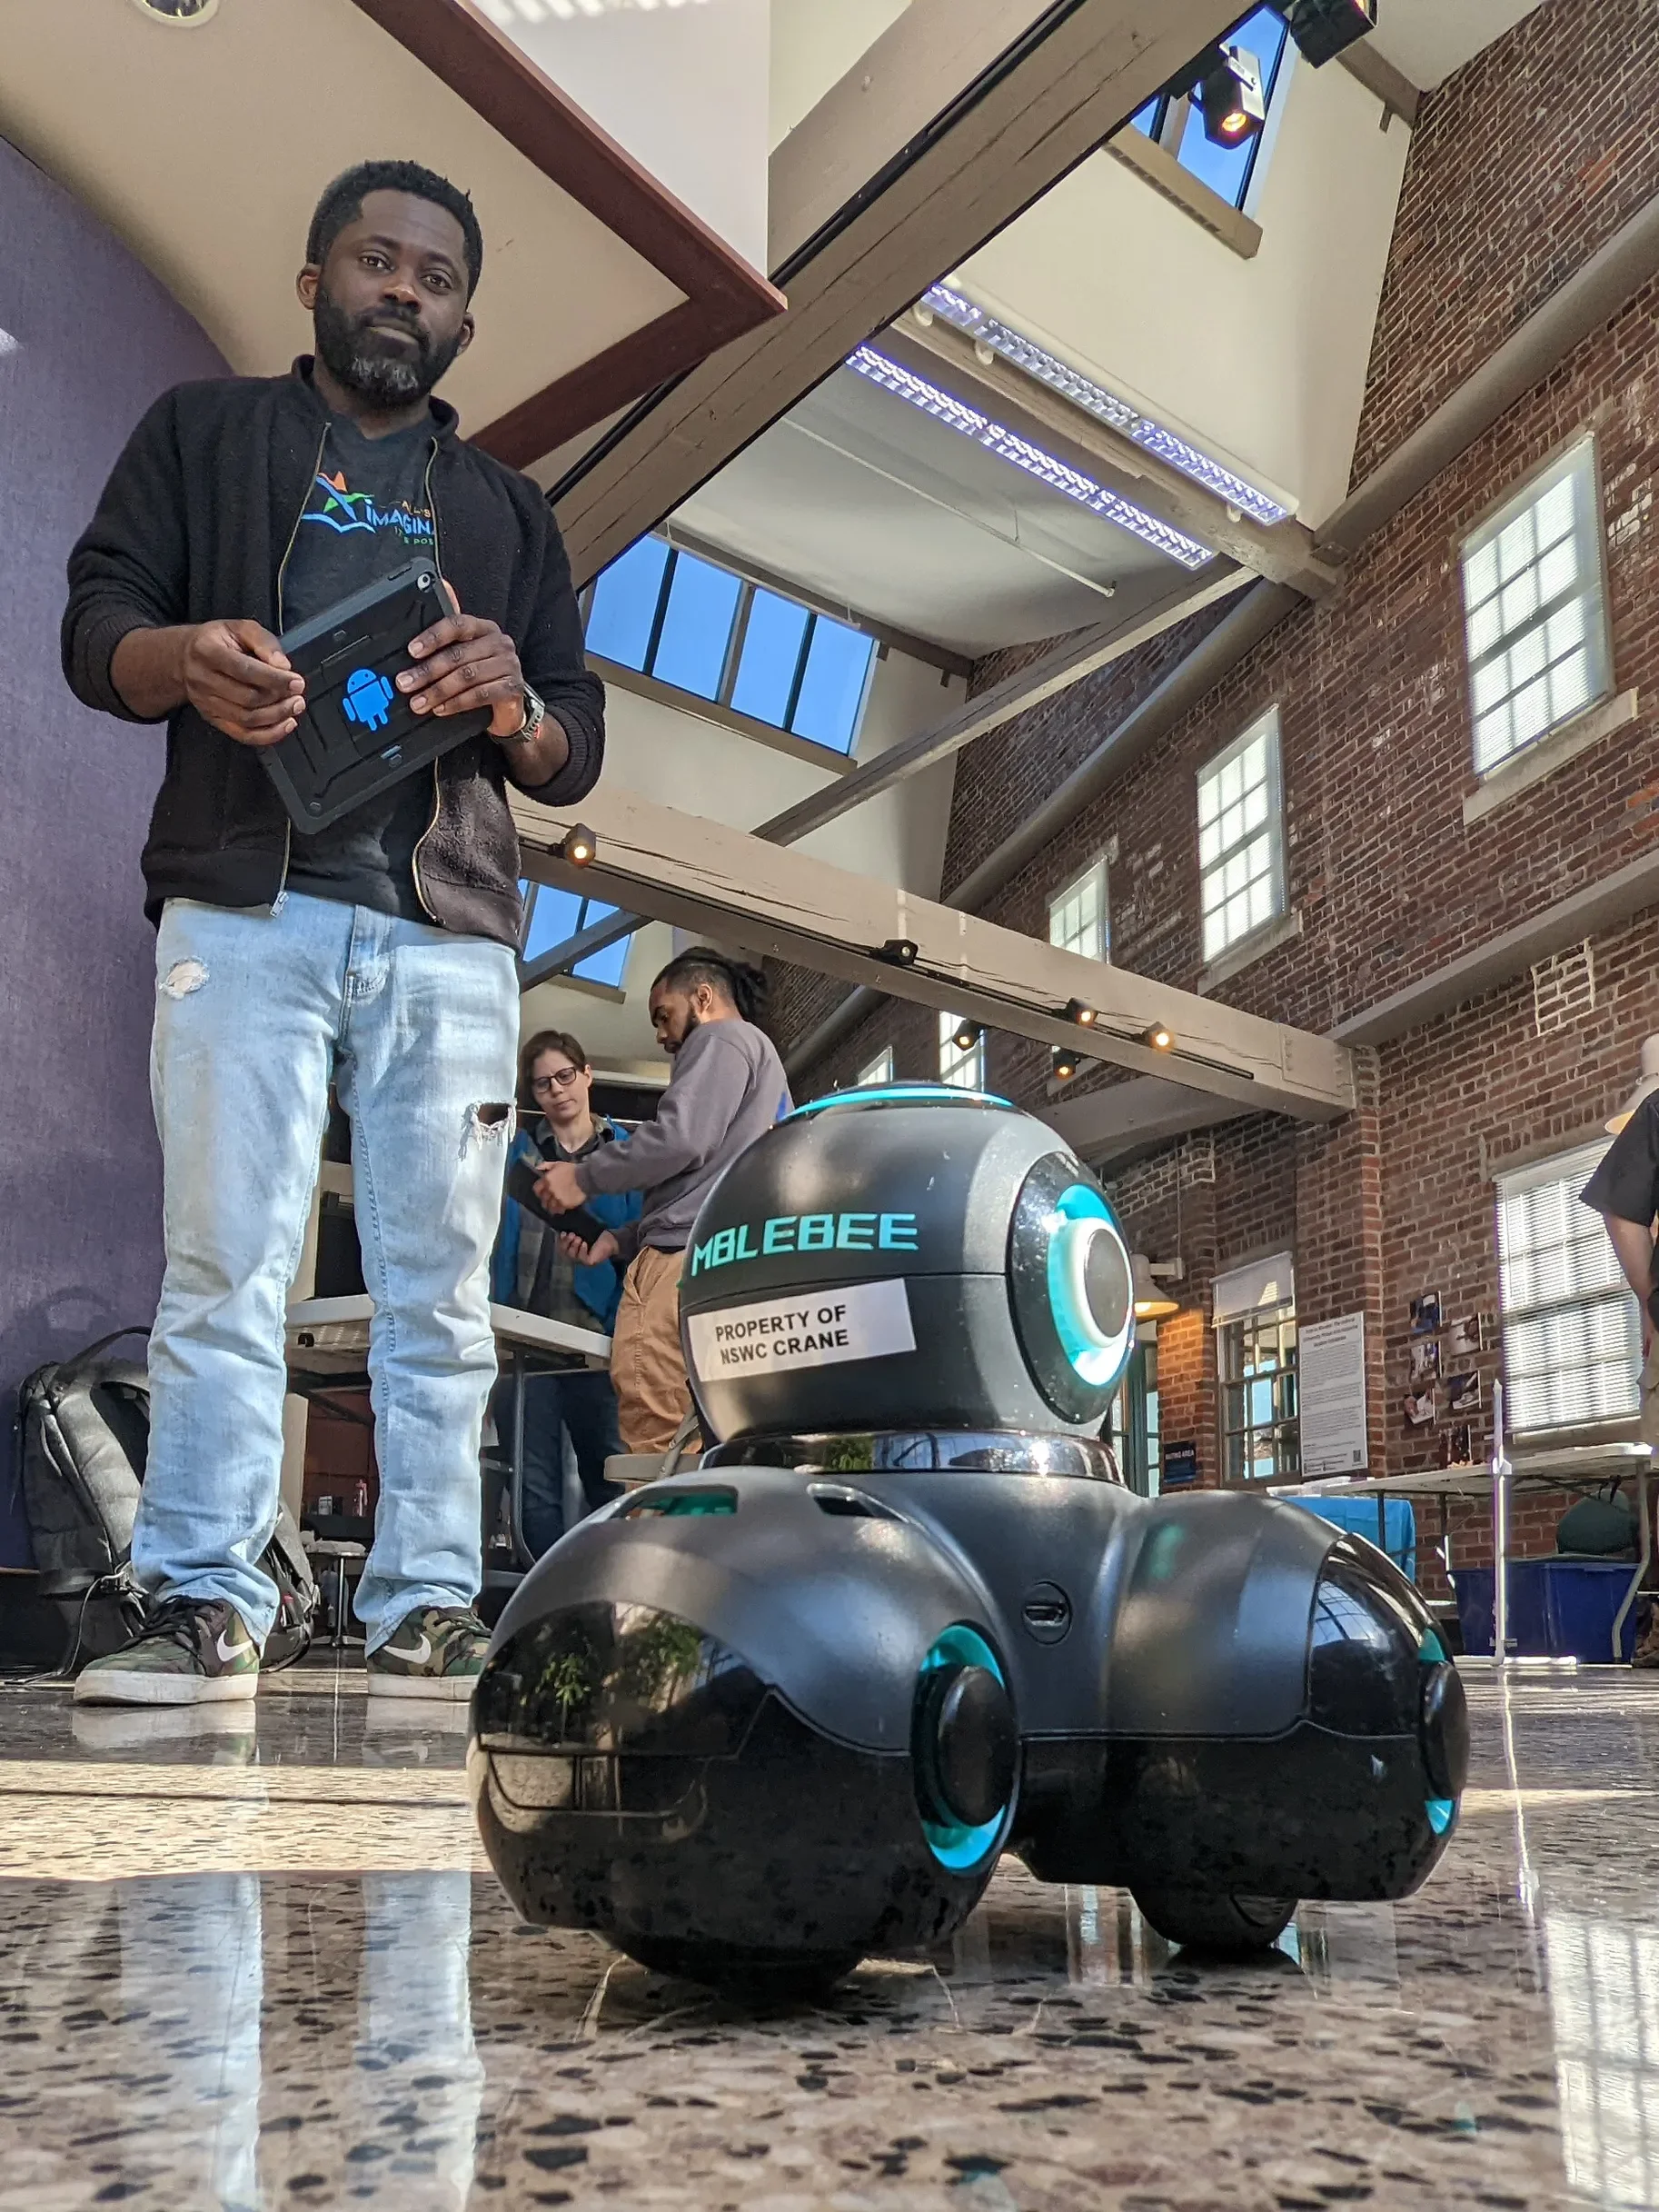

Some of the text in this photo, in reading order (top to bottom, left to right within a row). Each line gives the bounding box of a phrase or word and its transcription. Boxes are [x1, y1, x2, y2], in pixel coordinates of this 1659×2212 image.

[691, 1213, 919, 1276] MBLEBEE
[715, 1304, 847, 1342] PROPERTY OF
[720, 1329, 849, 1365] NSWC CRANE
